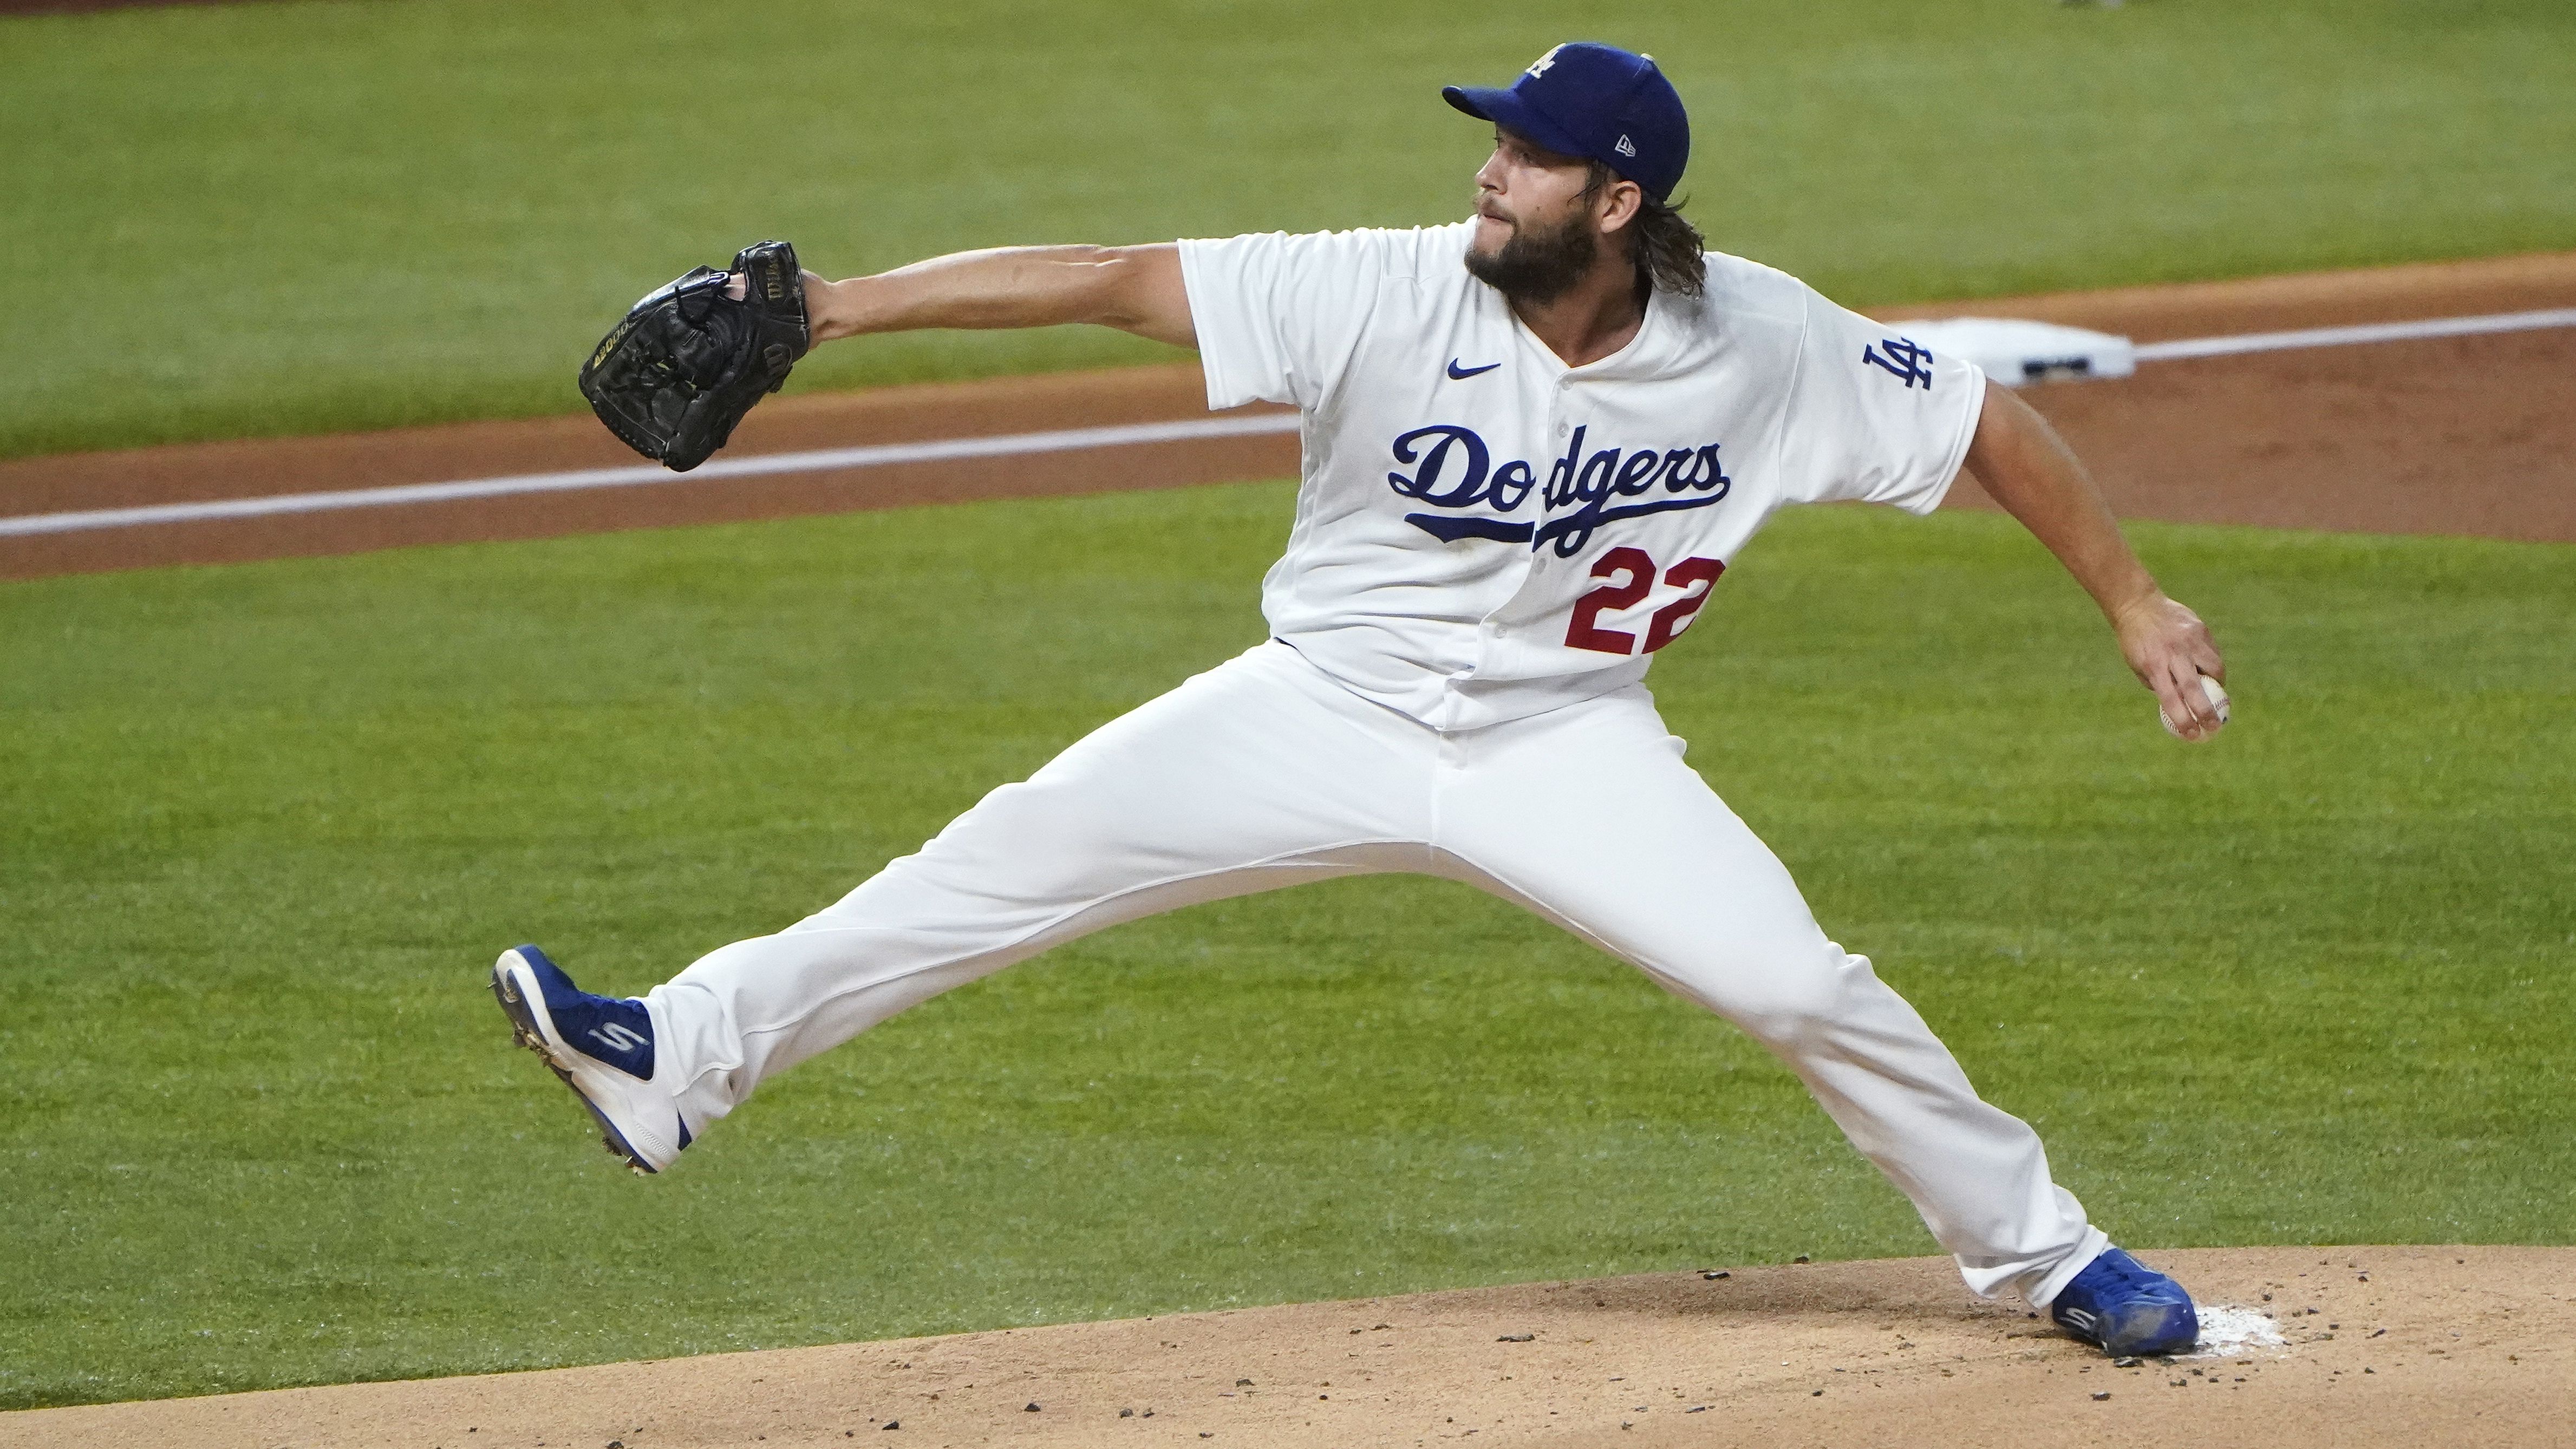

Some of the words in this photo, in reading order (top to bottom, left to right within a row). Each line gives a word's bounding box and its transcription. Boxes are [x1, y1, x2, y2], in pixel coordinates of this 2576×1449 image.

[1862, 336, 1933, 390] LA
[1388, 425, 1731, 558] Dodgers
[1564, 547, 1726, 655] 22
